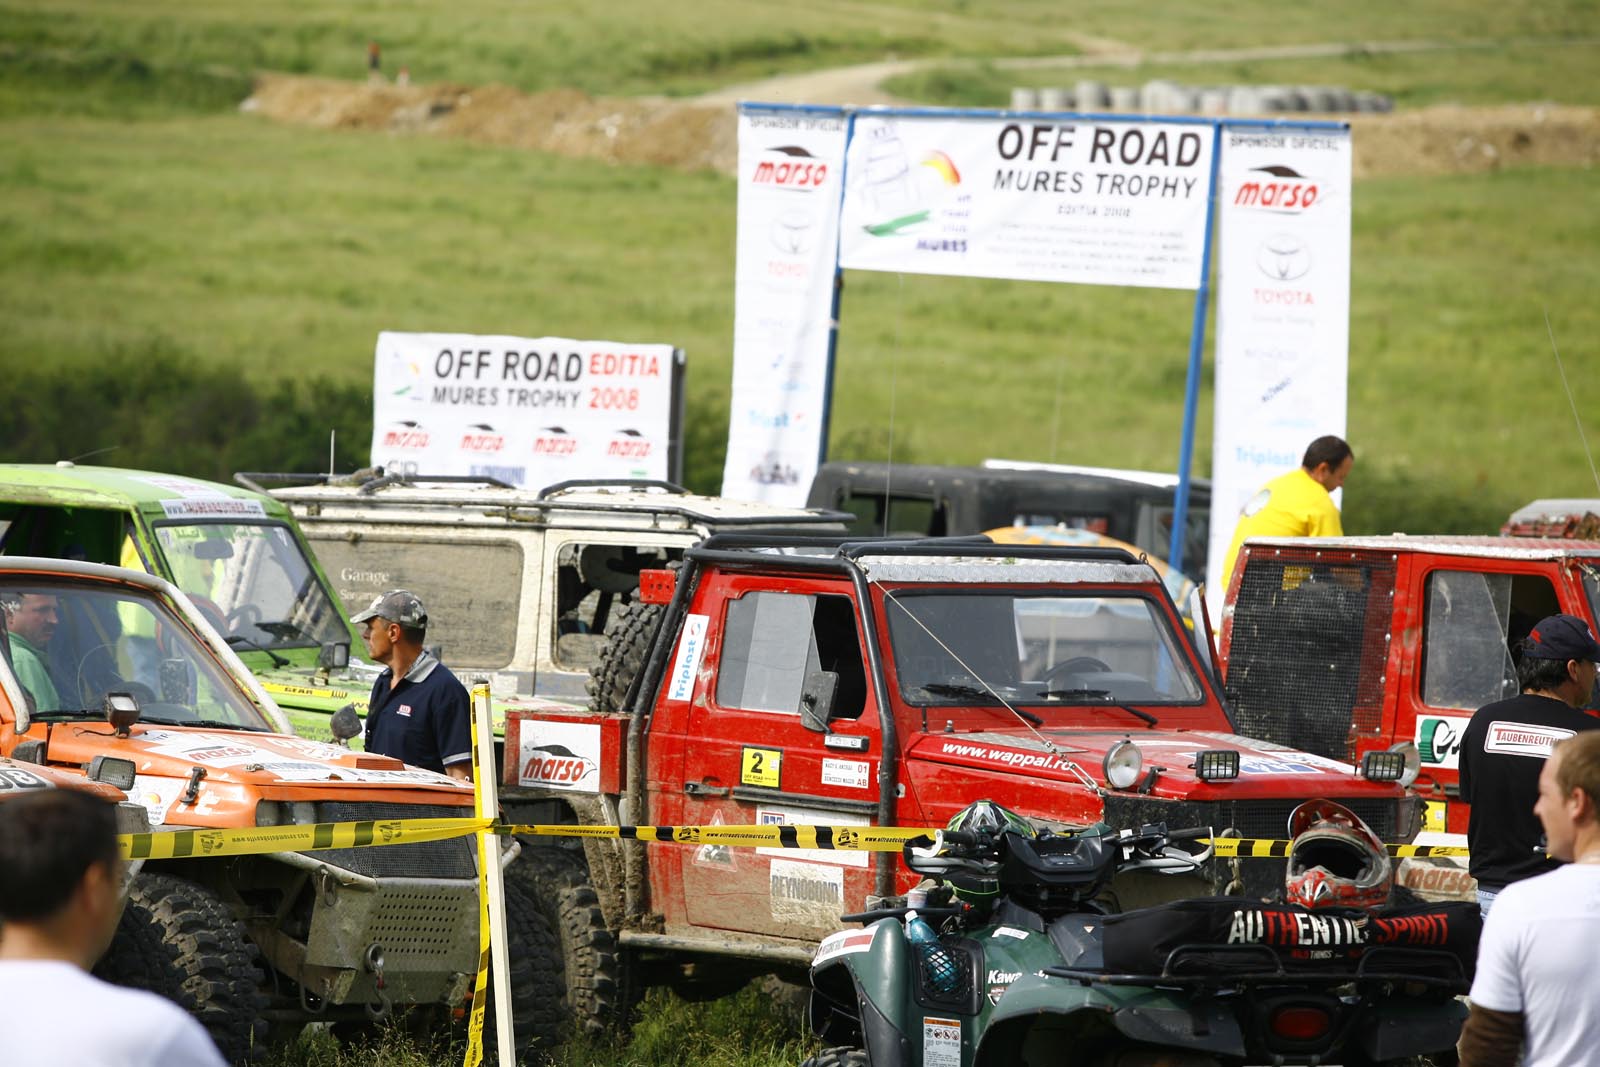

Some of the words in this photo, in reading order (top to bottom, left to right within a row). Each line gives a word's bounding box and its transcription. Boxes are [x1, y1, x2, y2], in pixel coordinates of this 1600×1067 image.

[998, 124, 1076, 161] OFF
[1089, 127, 1201, 167] ROAD
[752, 161, 828, 186] marso
[994, 169, 1084, 194] MURES
[1096, 173, 1197, 199] TROPHY
[1234, 182, 1319, 208] marso
[435, 349, 491, 379] OFF
[502, 351, 582, 382] ROAD
[589, 353, 660, 377] EDITIA
[432, 387, 499, 406] MURES
[506, 389, 582, 408] TROPHY
[589, 387, 641, 411] 2008
[341, 567, 390, 585] Garage
[675, 639, 697, 699] Triplast
[523, 757, 585, 782] marso
[750, 752, 764, 775] 2
[942, 743, 1073, 771] www.wappal.ro
[1404, 867, 1473, 893] marso
[1375, 913, 1449, 945] SPIRIT
